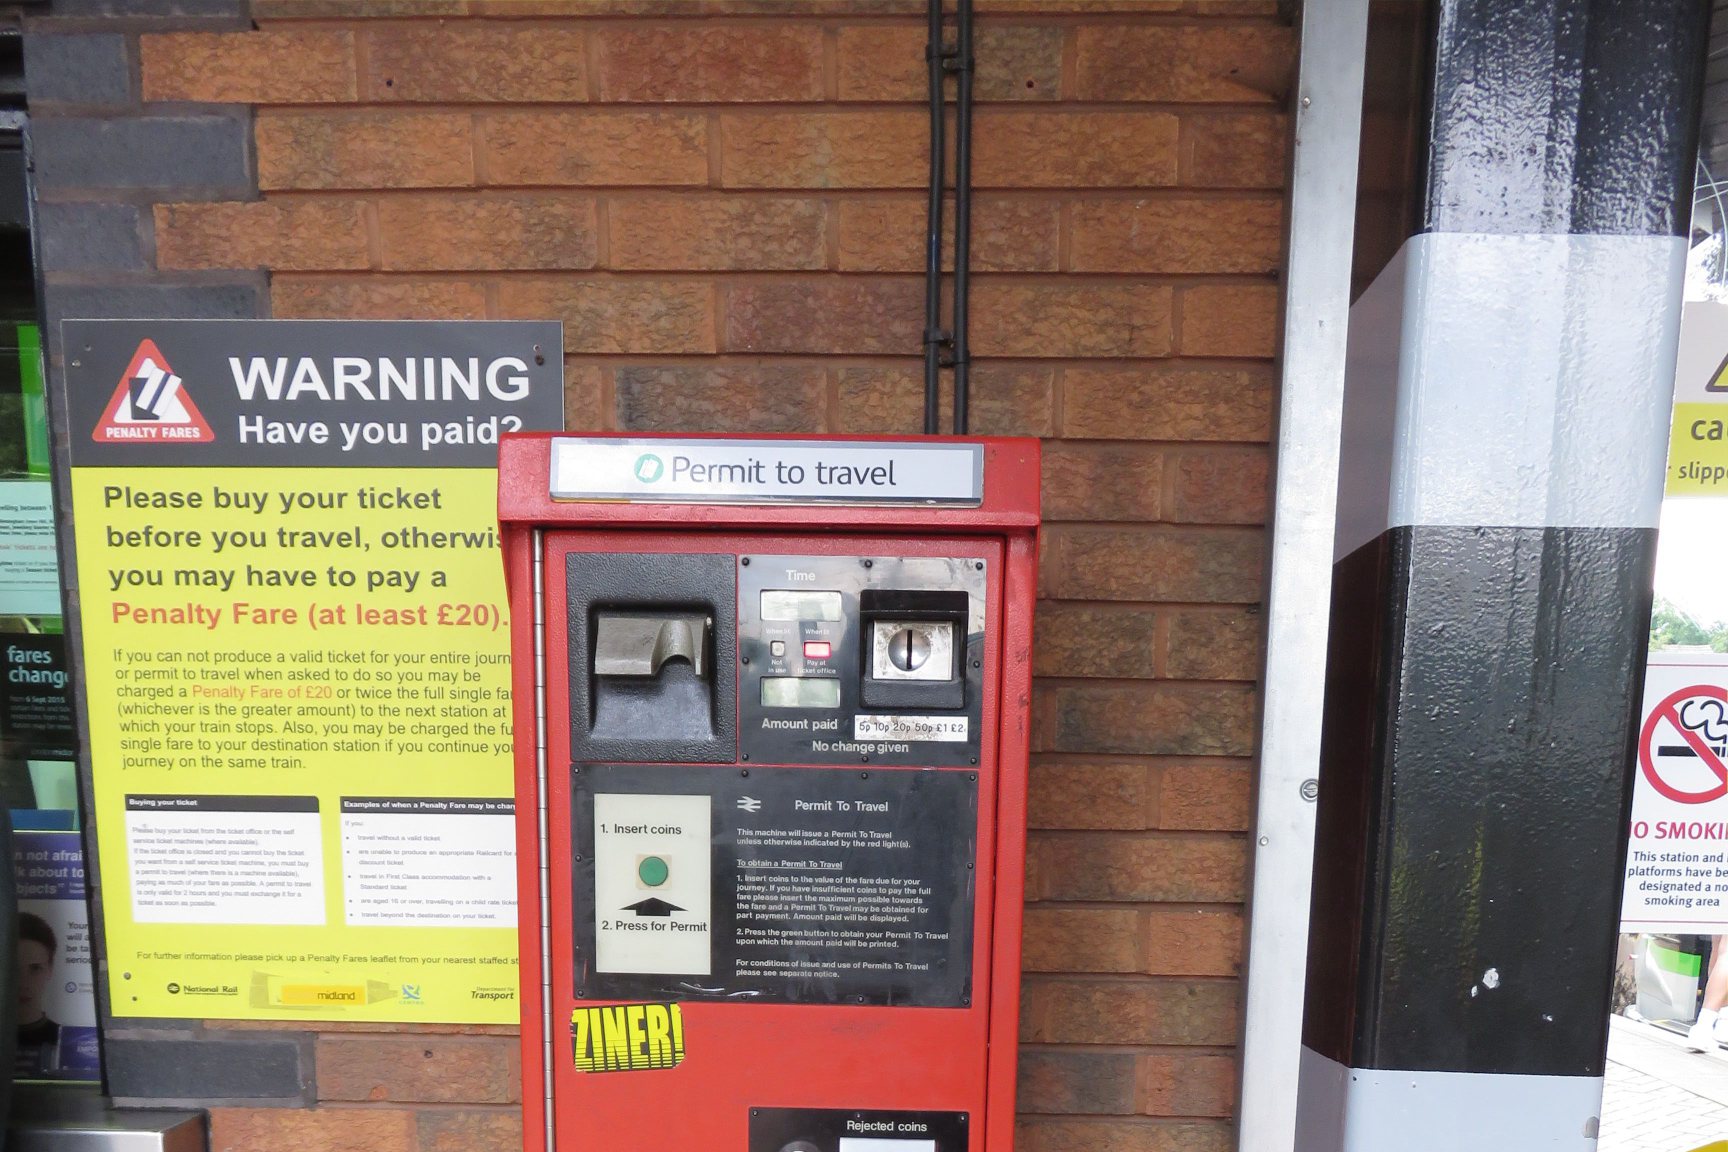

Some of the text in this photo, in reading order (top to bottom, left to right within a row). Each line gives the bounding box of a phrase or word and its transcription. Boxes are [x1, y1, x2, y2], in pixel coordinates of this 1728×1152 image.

[229, 357, 529, 400] WARNING
[106, 427, 200, 437] PENALTY FARES
[239, 415, 328, 443] Have
[340, 422, 407, 450] you
[1690, 420, 1728, 440] ca
[673, 456, 895, 485] Permit to travel
[104, 486, 441, 514] Please buy your ticket
[106, 525, 200, 547] before
[212, 531, 266, 552] you
[277, 526, 369, 550] travel,
[108, 565, 446, 592] you may have to pay a
[785, 569, 815, 580] Time
[112, 602, 508, 630] Penalty Fare (at least £20).
[6, 646, 52, 663] fares
[113, 649, 121, 661] If
[126, 652, 151, 664] you
[156, 652, 181, 661] can
[187, 650, 209, 662] not
[214, 650, 271, 664] produce
[276, 652, 284, 662] a
[289, 650, 322, 662] valid
[327, 650, 365, 663] ticket
[370, 650, 389, 663] for
[393, 653, 425, 666] your
[430, 651, 470, 663] entire
[115, 667, 480, 684] or permit to travel when asked to do so you may be
[762, 718, 837, 731] Amount paid
[859, 722, 870, 732] 5p
[874, 722, 890, 733] 10p
[893, 723, 910, 733] 20p
[915, 723, 933, 733] 50p
[936, 724, 948, 732] £1
[812, 740, 908, 754] No change given
[122, 755, 305, 770] journey on the same train.
[129, 798, 155, 806] Buying
[795, 800, 888, 811] Permit To Travel
[600, 824, 681, 834] 1. Insert coins
[1628, 821, 1728, 840] O SMOKI
[841, 839, 850, 847] by
[882, 840, 910, 848] light(s).
[1633, 851, 1723, 863] This station and
[29, 868, 68, 878] about
[1628, 866, 1682, 878] platforms
[1685, 867, 1712, 877] have
[1639, 880, 1702, 893] designated
[1705, 884, 1711, 892] a
[1644, 895, 1693, 908] smoking
[602, 920, 707, 931] 2. Press for Permit
[184, 952, 232, 960] information
[307, 954, 340, 963] Penalty
[342, 954, 368, 962] Fares
[478, 956, 508, 964] staffed
[184, 985, 218, 993] National
[317, 991, 355, 1000] midland
[471, 991, 514, 1001] Transport
[847, 1120, 927, 1132] Rejected coins
